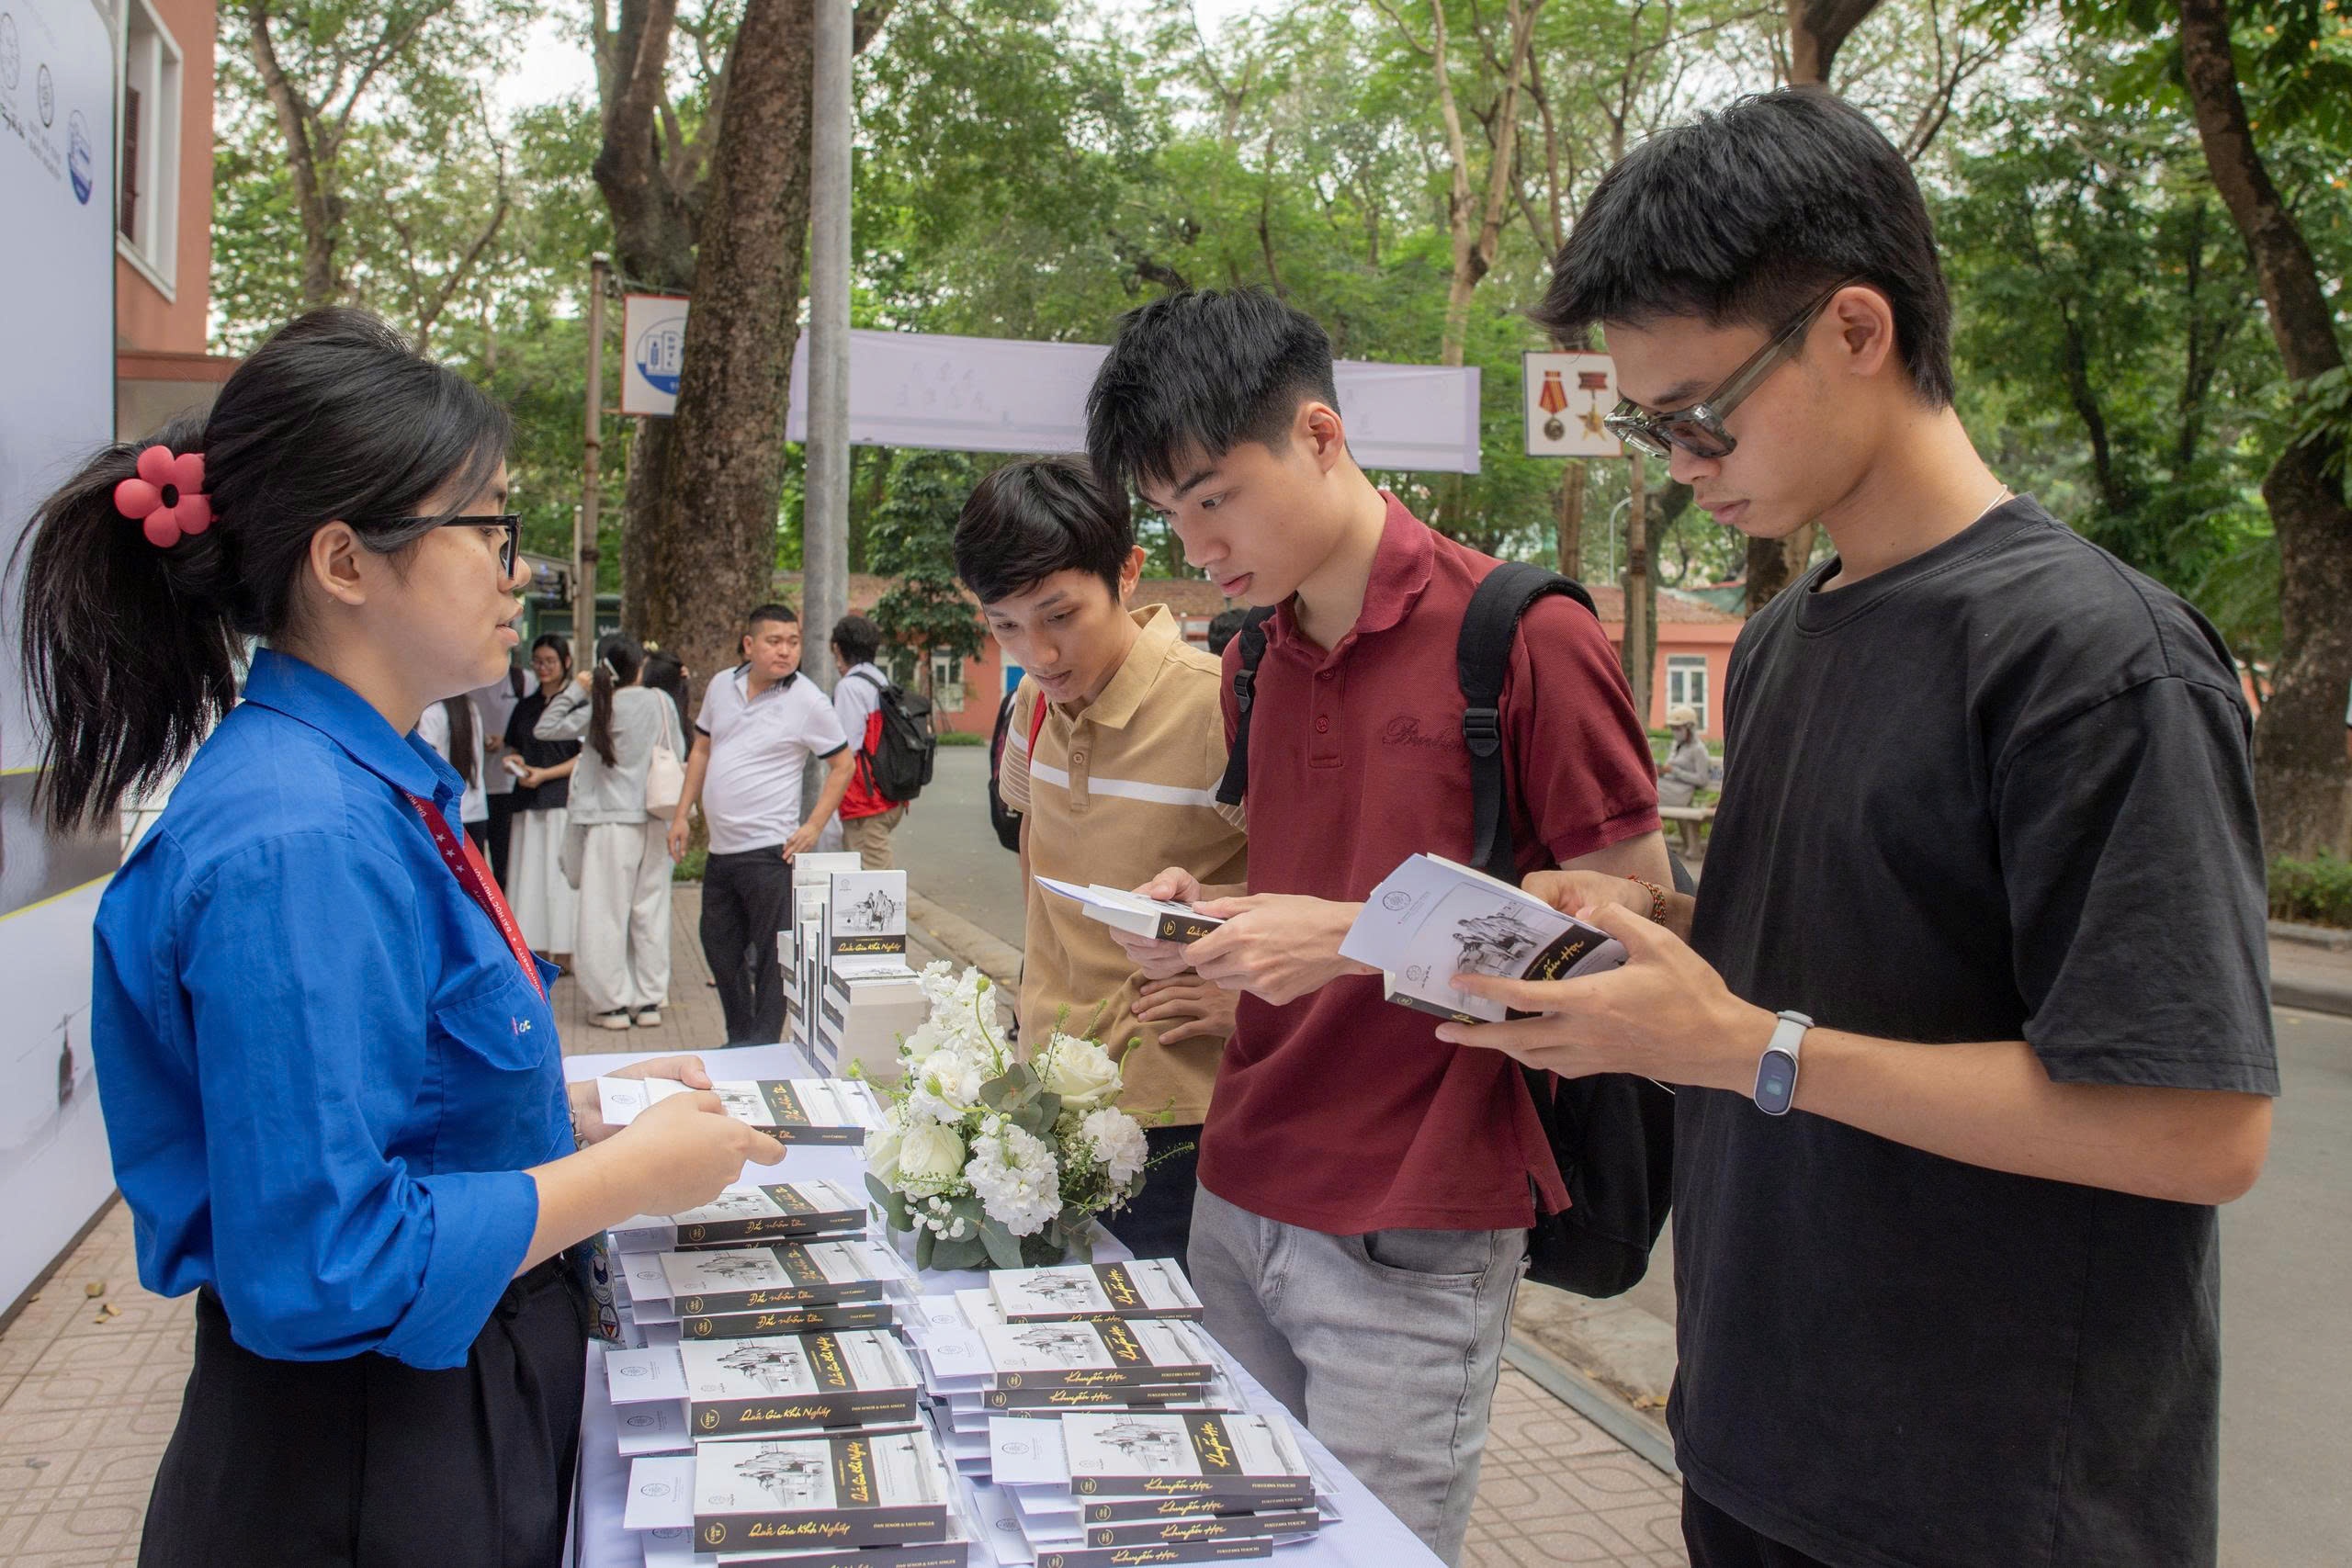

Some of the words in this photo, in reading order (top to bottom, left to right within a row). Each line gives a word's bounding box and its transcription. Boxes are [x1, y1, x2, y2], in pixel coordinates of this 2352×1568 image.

[1561, 940, 1585, 961] Học
[1064, 1371, 1104, 1385] Khuyến
[1049, 1390, 1090, 1404] Khuyến
[764, 1409, 782, 1420] Gia
[1144, 1478, 1189, 1495] Khuyến
[1189, 1480, 1213, 1492] Học
[1158, 1500, 1200, 1516] Khuyến
[1201, 1500, 1225, 1511] Học
[776, 1523, 796, 1536] Gia
[1159, 1524, 1203, 1540] Khuyến
[1204, 1525, 1227, 1535] Học
[1111, 1550, 1154, 1565] Khuyến
[1155, 1551, 1179, 1562] Học
